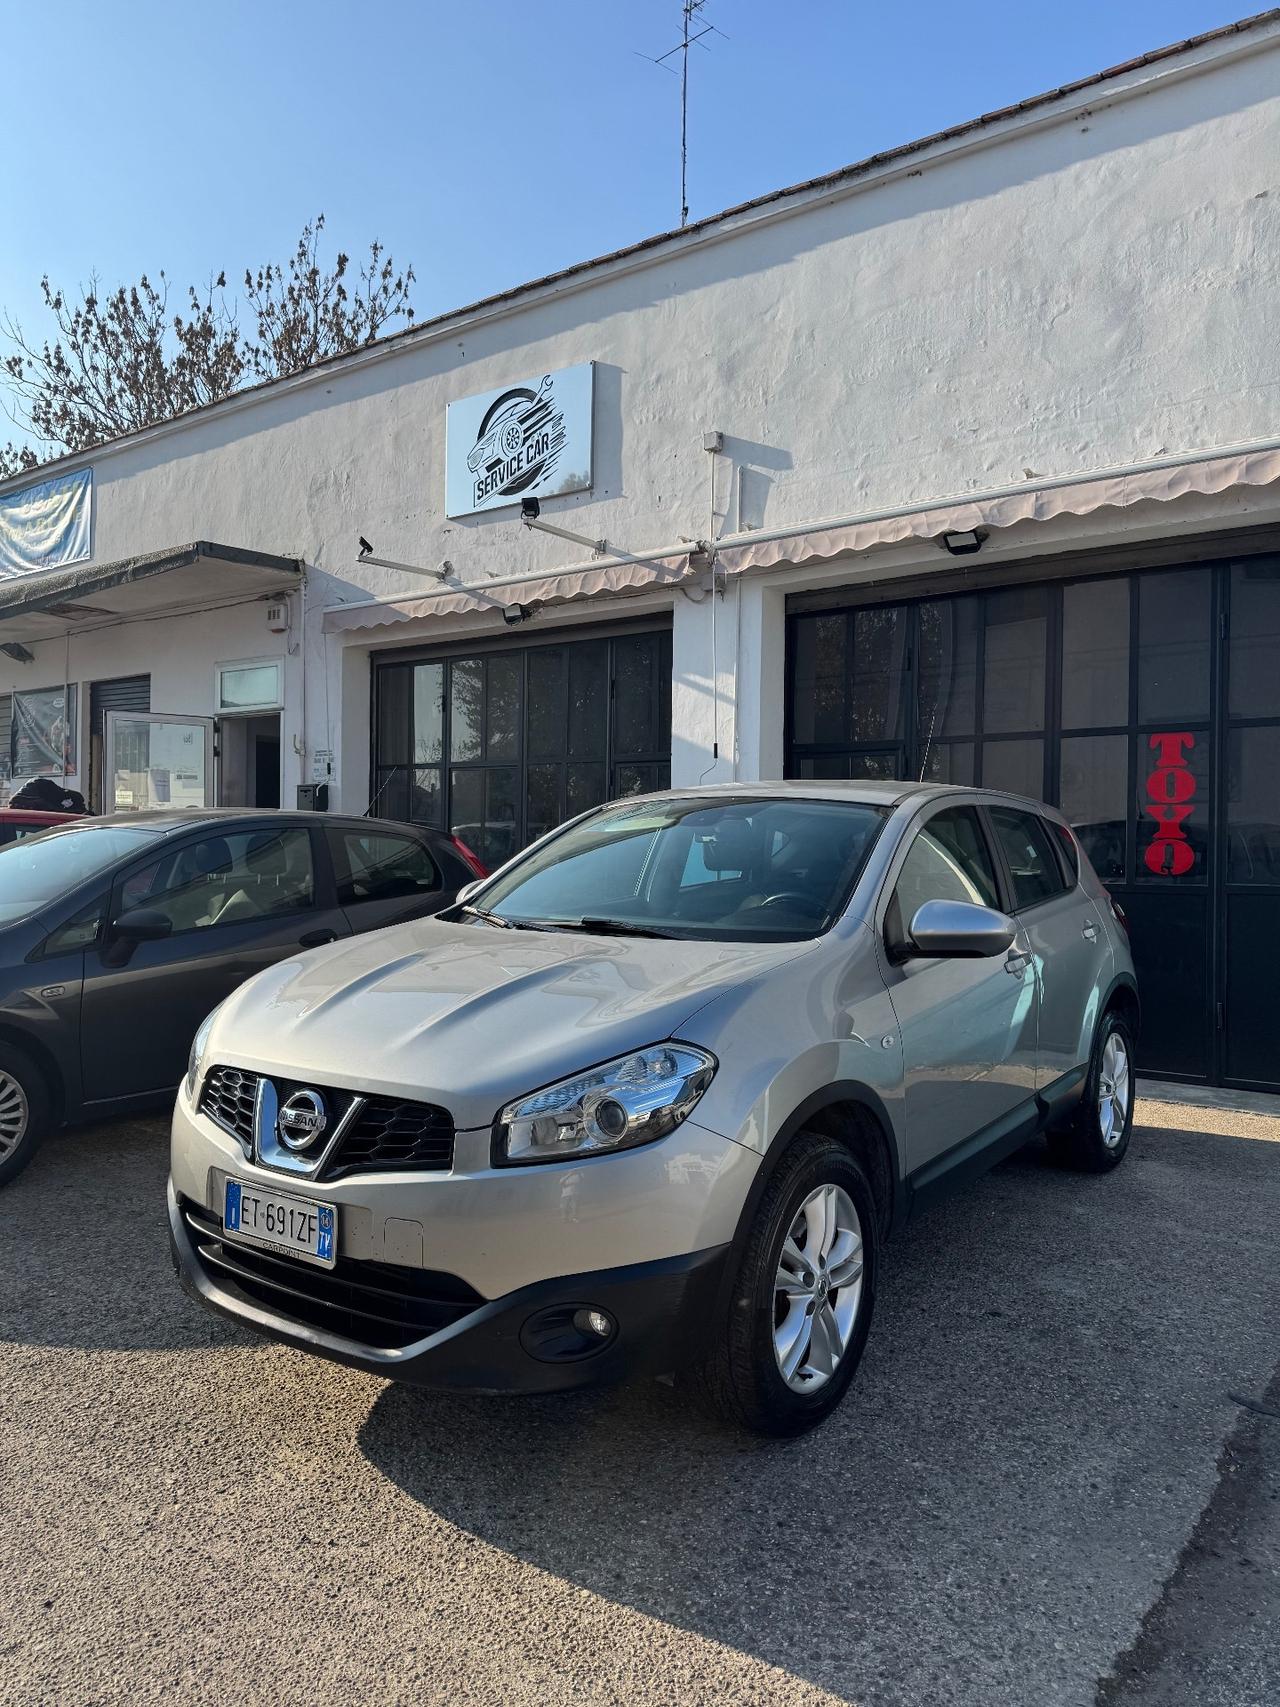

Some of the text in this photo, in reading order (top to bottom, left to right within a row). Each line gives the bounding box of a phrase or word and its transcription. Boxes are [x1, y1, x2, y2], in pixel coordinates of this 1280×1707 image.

[477, 432, 549, 500] SERVICE CAR
[1145, 732, 1196, 875] TOYO
[280, 1110, 318, 1127] NISSAN
[241, 1195, 317, 1244] ET 691ZF
